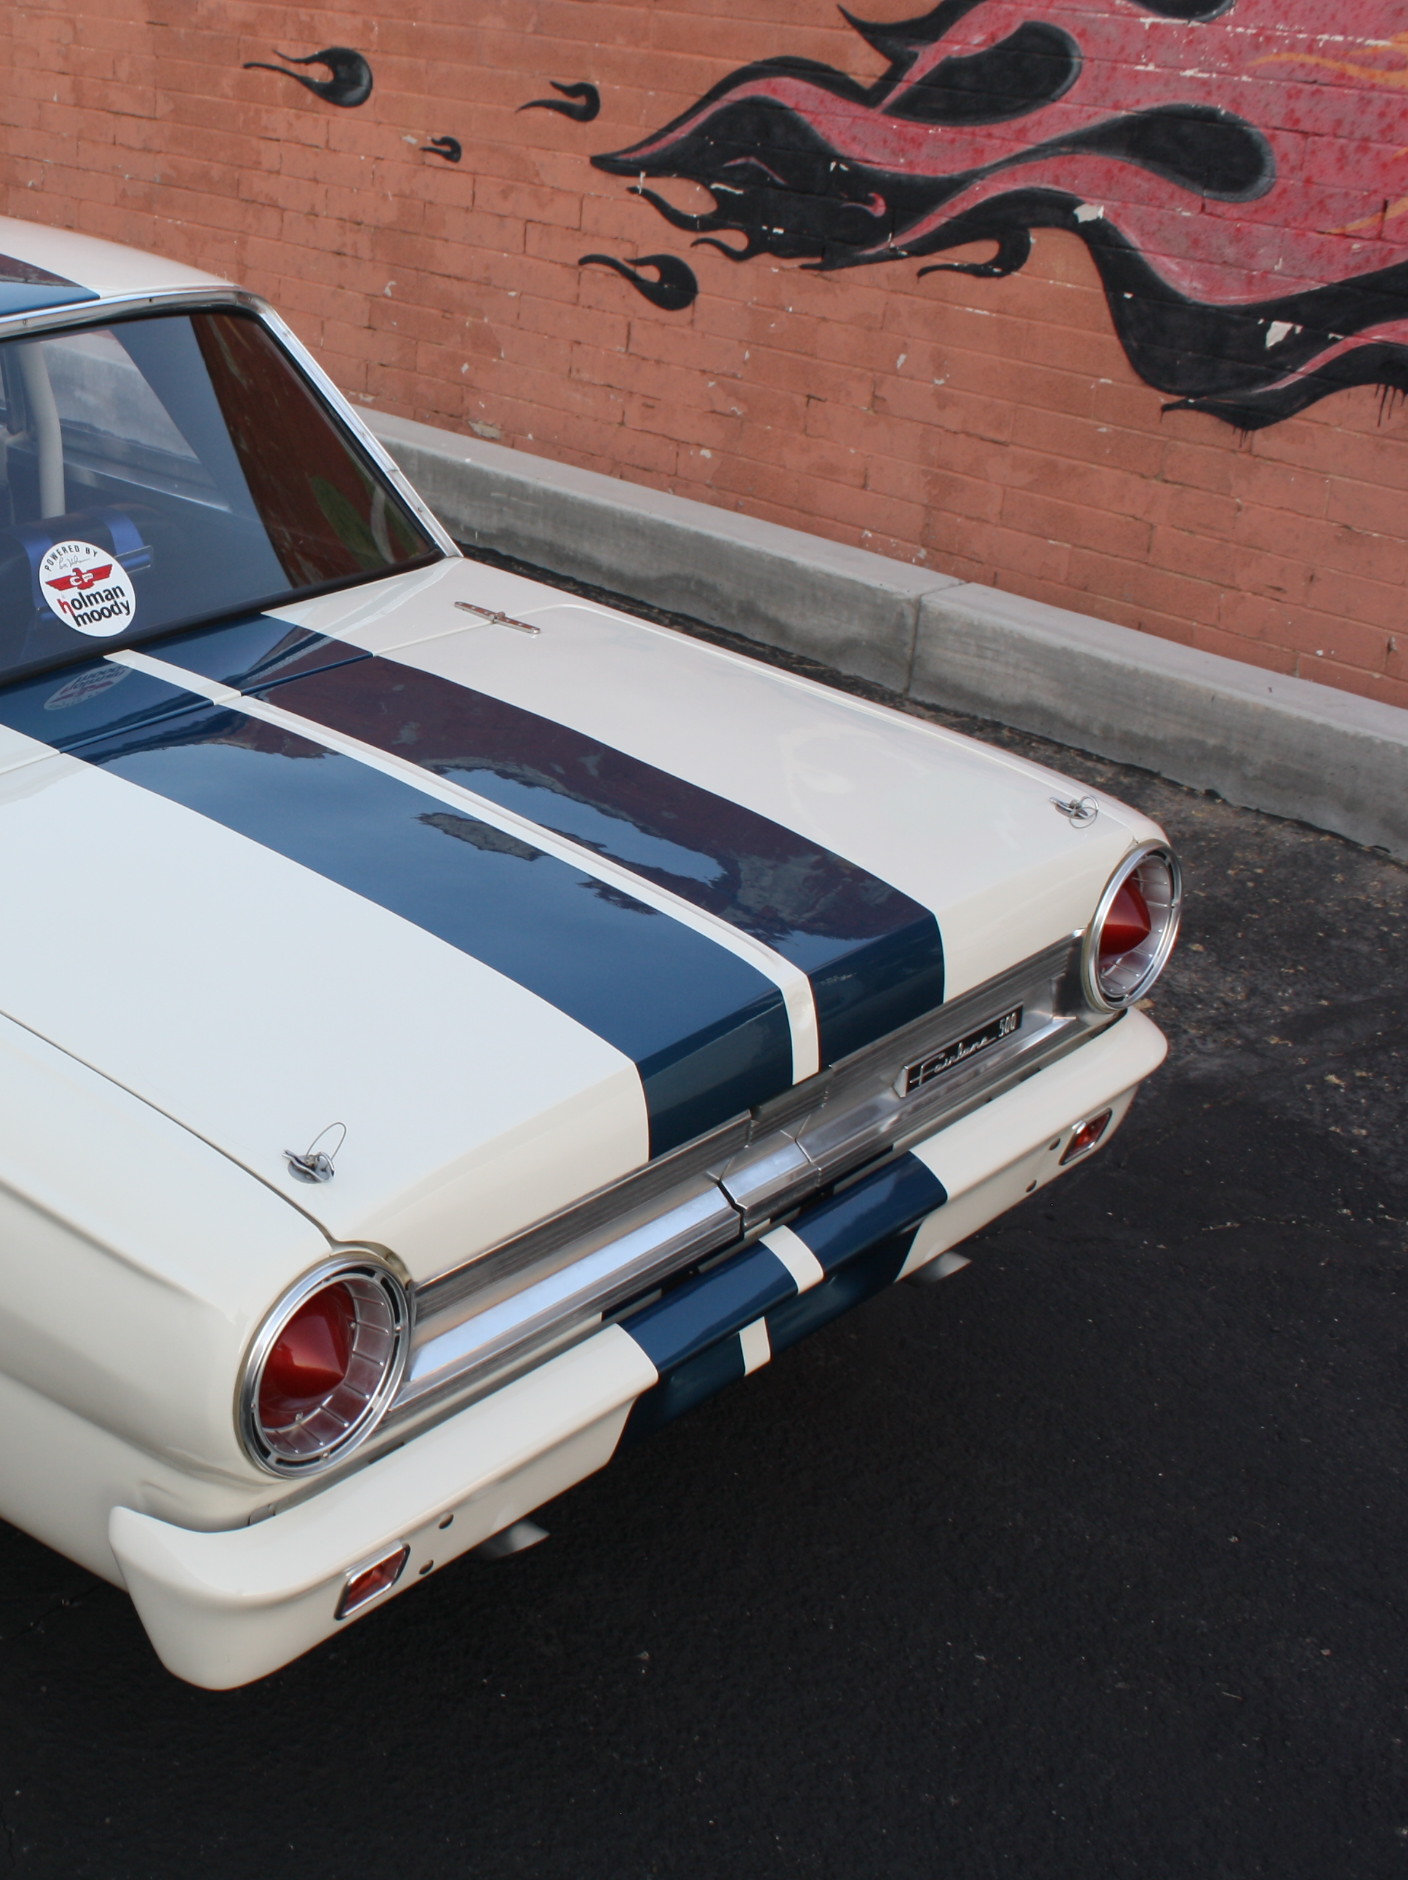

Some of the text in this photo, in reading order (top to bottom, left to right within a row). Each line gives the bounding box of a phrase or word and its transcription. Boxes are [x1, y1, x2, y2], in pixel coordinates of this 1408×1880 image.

[44, 545, 80, 571] POWERED
[85, 547, 98, 558] BY
[57, 585, 125, 616] holman
[73, 600, 131, 627] moody
[909, 1012, 1017, 1087] Fairlane 500
